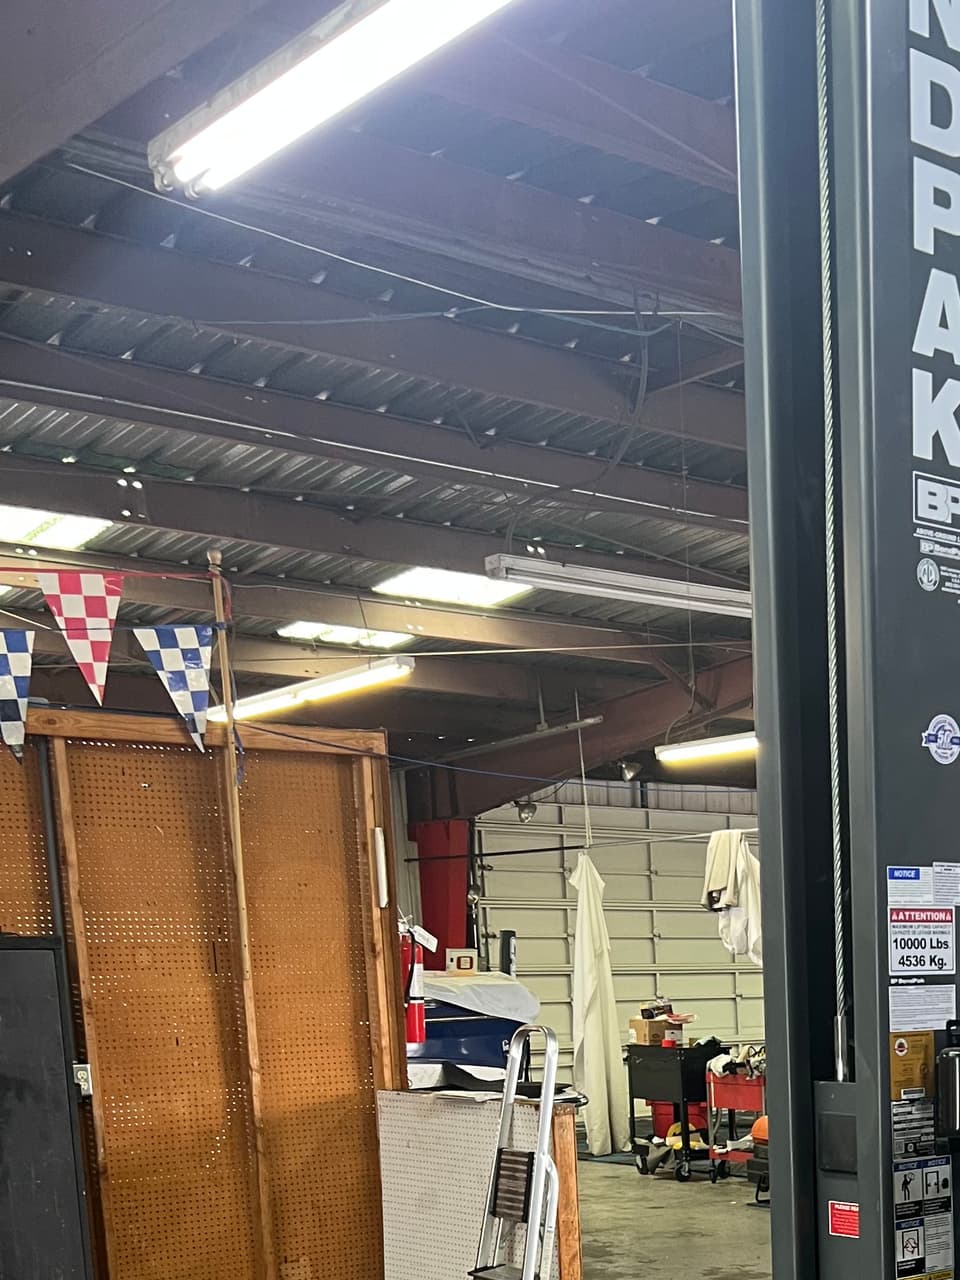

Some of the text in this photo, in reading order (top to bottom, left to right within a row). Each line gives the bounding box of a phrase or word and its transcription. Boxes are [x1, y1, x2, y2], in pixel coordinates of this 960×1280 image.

[893, 870, 916, 878] NOTICE
[898, 911, 946, 921] ATTENTION
[893, 937, 927, 950] 10000
[898, 954, 926, 967] 4536
